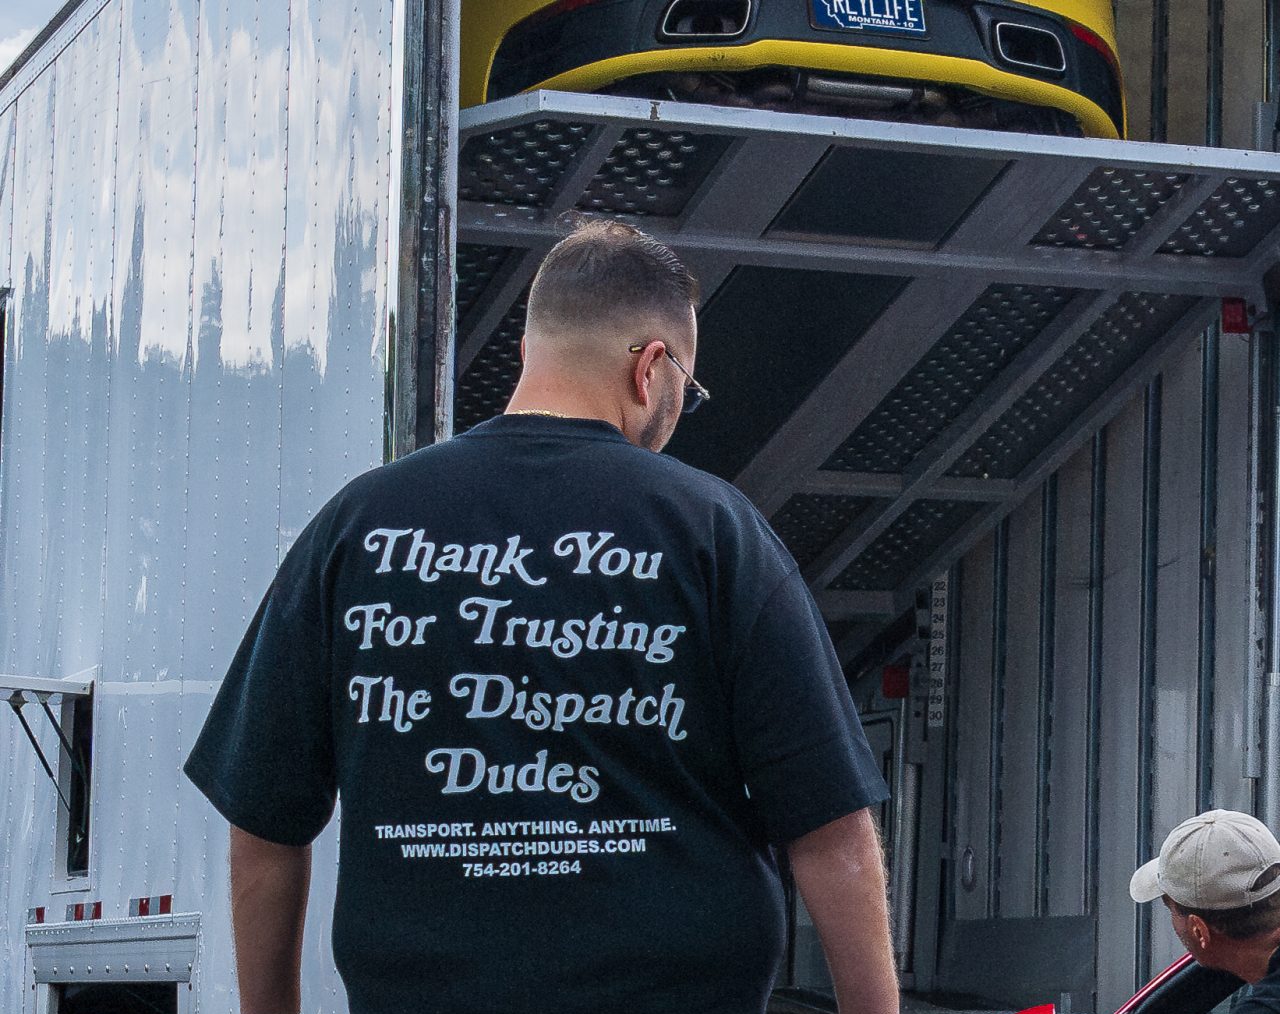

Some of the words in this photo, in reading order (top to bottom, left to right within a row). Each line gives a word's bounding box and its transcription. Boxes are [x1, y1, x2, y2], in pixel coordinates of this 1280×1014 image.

[849, 15, 895, 26] MONTANA
[364, 528, 547, 585] Thank
[553, 532, 663, 579] You
[934, 581, 946, 591] 22
[933, 597, 945, 607] 23
[344, 602, 437, 650] For
[459, 597, 686, 663] Trusting
[349, 676, 432, 732] The
[449, 673, 687, 741] Dispatch
[929, 710, 942, 720] 30
[425, 748, 600, 803] Dudes
[375, 822, 477, 839] TRANSPORT.
[481, 820, 584, 837] ANYTHING.
[588, 818, 677, 833] ANYTIME.
[401, 839, 646, 858] WWW.DISPATCHDUDES.COM
[463, 860, 582, 877] 754-201-8264
